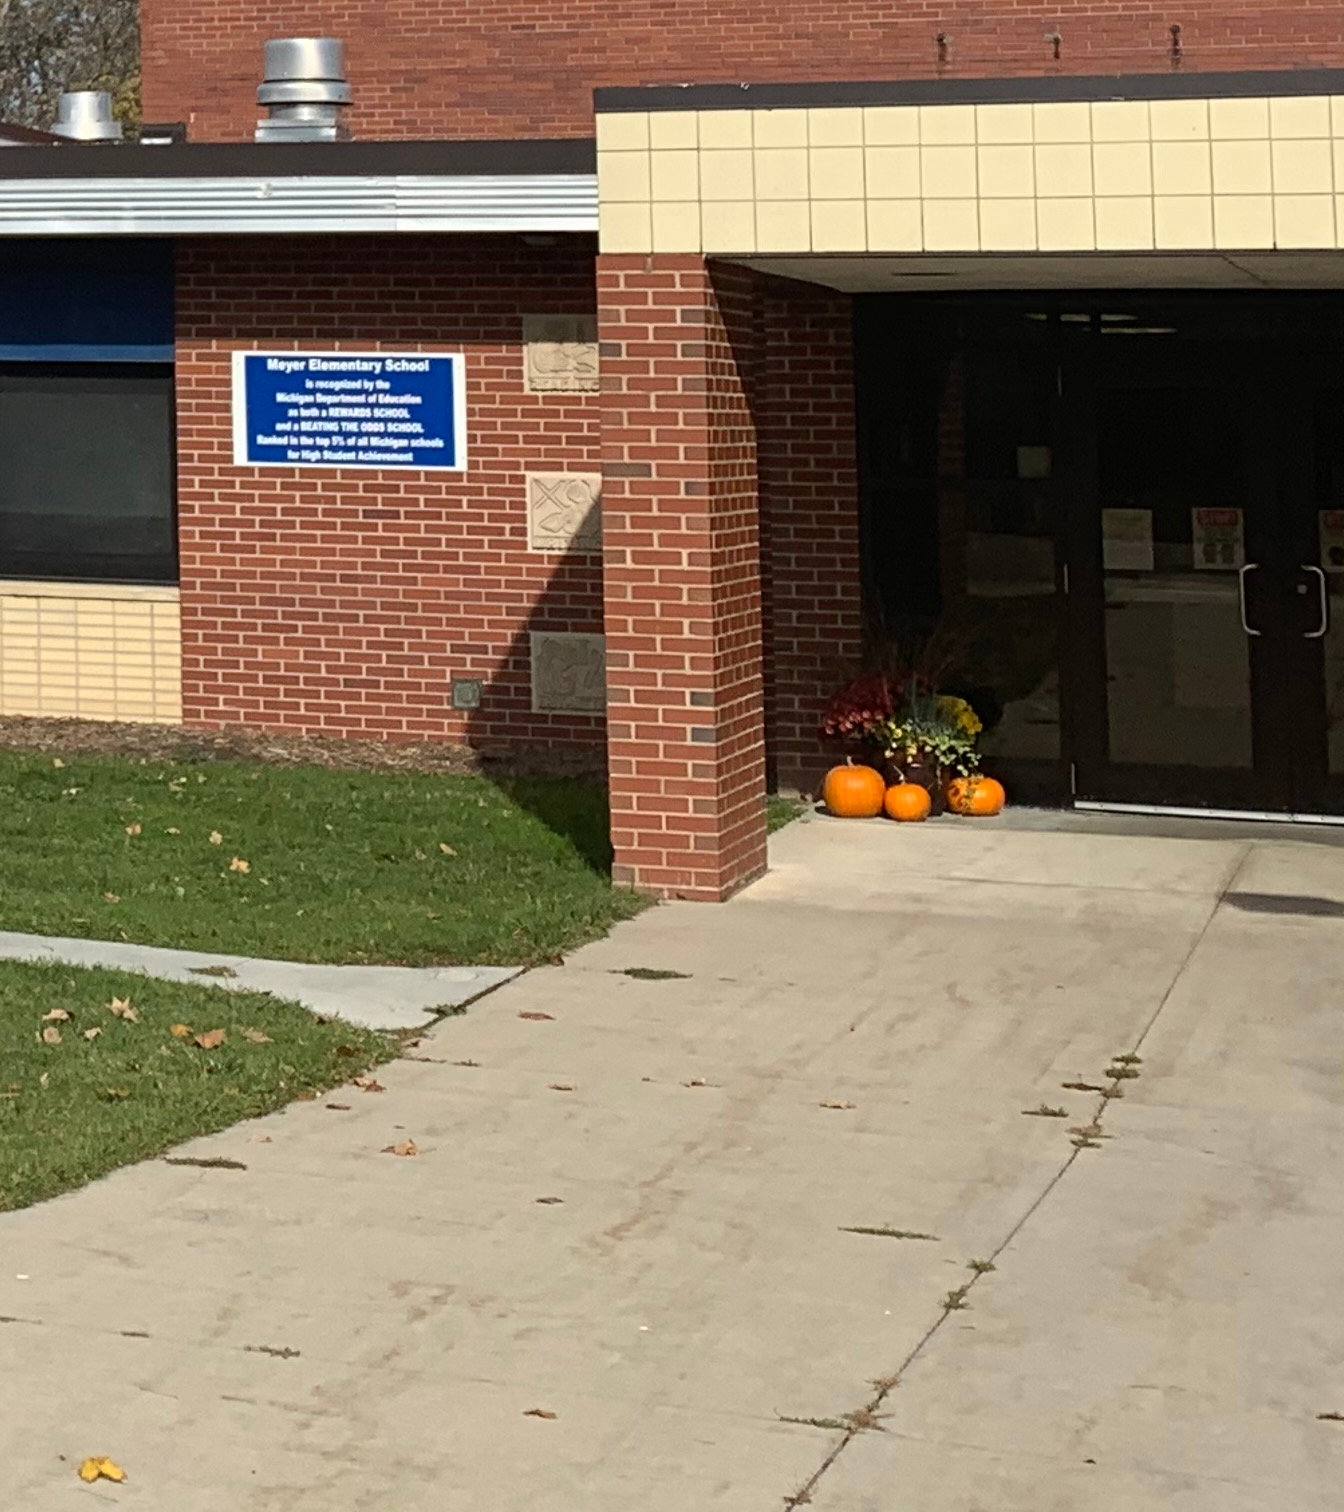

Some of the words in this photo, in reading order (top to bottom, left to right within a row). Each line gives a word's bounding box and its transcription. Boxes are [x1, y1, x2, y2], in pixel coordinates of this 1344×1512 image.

[266, 358, 306, 374] Meyer
[308, 358, 382, 374] Elementary
[385, 358, 430, 372] School
[305, 378, 314, 389] is
[315, 378, 362, 391] recognized
[363, 378, 374, 392] by
[375, 378, 391, 390] the
[275, 392, 315, 405] Michigan
[315, 392, 366, 405] Department
[367, 392, 377, 404] of
[378, 392, 422, 405] Education
[287, 408, 299, 418] as
[299, 407, 320, 418] both
[328, 407, 372, 419] REWARDS
[373, 407, 411, 419] SCHOOL
[275, 421, 292, 432] and
[300, 420, 340, 432] BEATING
[340, 420, 359, 432] THE
[387, 421, 425, 434] SCHOOL
[256, 434, 289, 446] Ranked
[289, 434, 299, 446] in
[299, 434, 314, 446] the
[315, 435, 331, 448] top
[331, 435, 346, 447] 5%
[346, 435, 356, 447] of
[357, 435, 369, 447] all
[370, 435, 409, 450] Michigan
[410, 436, 445, 449] schools
[287, 449, 300, 460] for
[301, 449, 321, 462] High
[322, 449, 356, 461] Student
[357, 450, 414, 462] Achievement
